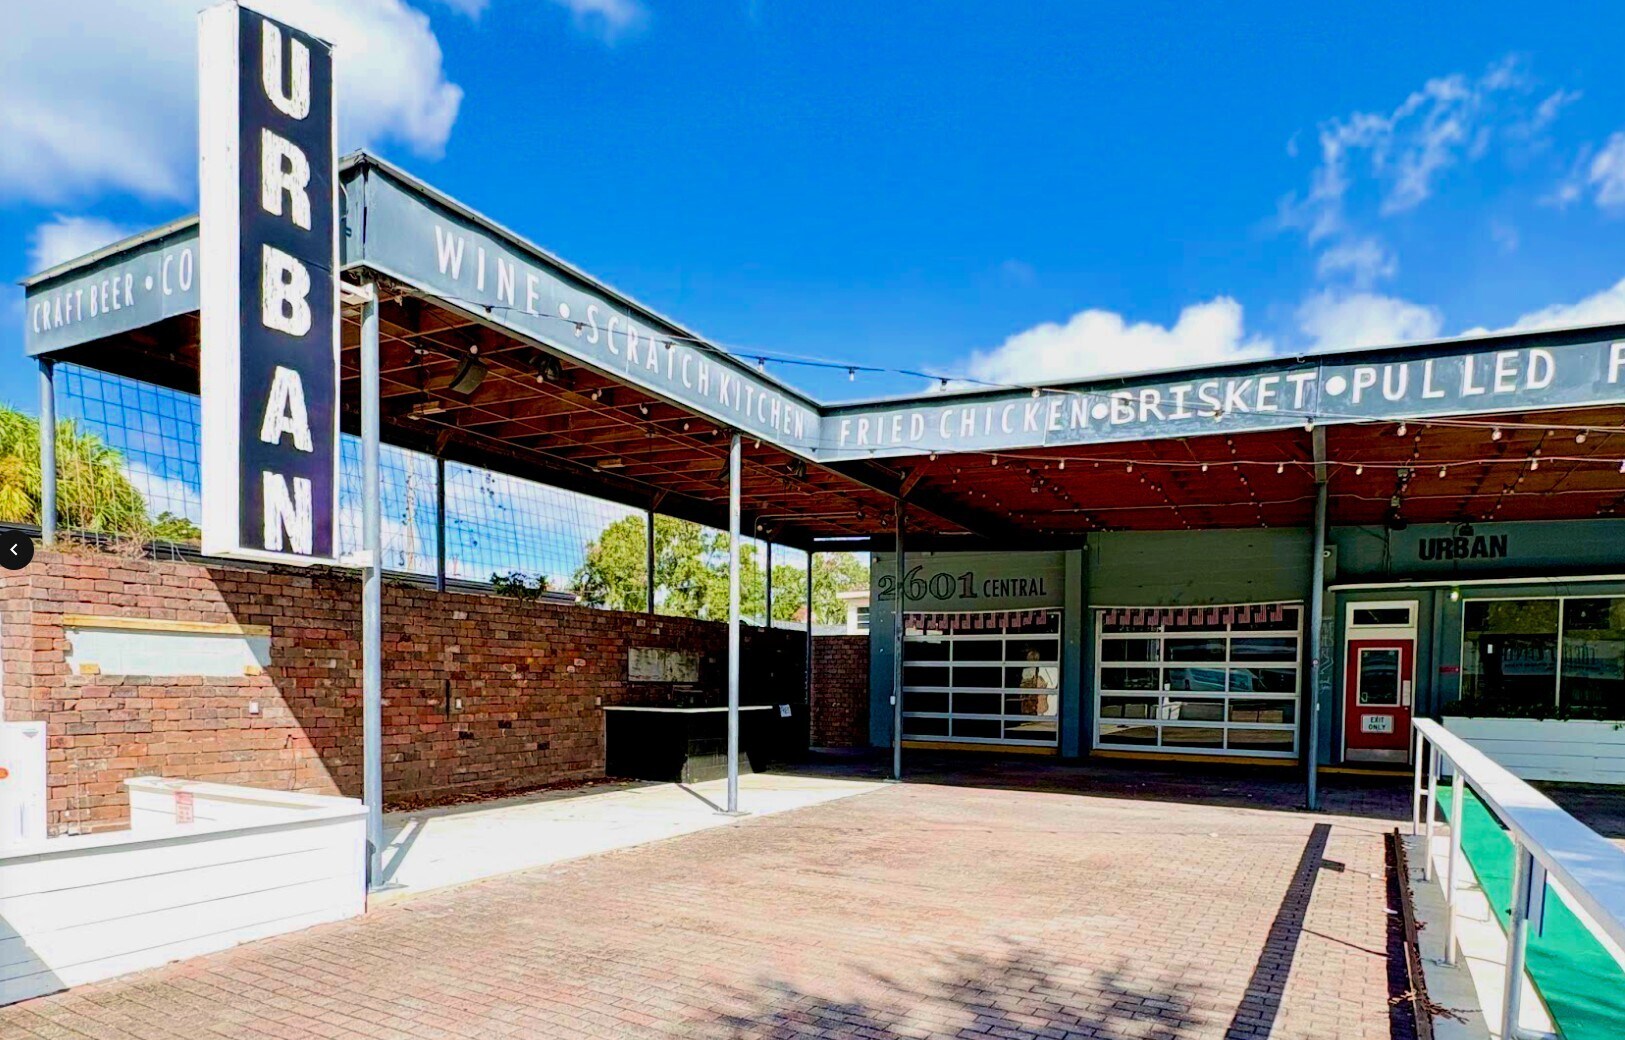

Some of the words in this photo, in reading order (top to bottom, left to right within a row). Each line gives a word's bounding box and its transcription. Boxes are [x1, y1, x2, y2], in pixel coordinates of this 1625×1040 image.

[33, 290, 83, 334] CRAFT
[90, 272, 135, 318] BEER
[260, 18, 313, 556] URBAN
[434, 224, 541, 318] WINE
[585, 303, 711, 397] SCRATCH
[718, 371, 805, 441] KITCHEN
[840, 413, 926, 446] FRIED
[939, 397, 1090, 441] CHICKEN
[1109, 372, 1317, 426] BRISKET
[1351, 348, 1556, 404] PULLED
[1418, 534, 1508, 561] URBAN
[877, 565, 978, 602] 2601
[983, 577, 1047, 598] CENTRAL
[1368, 723, 1386, 731] ONLY
